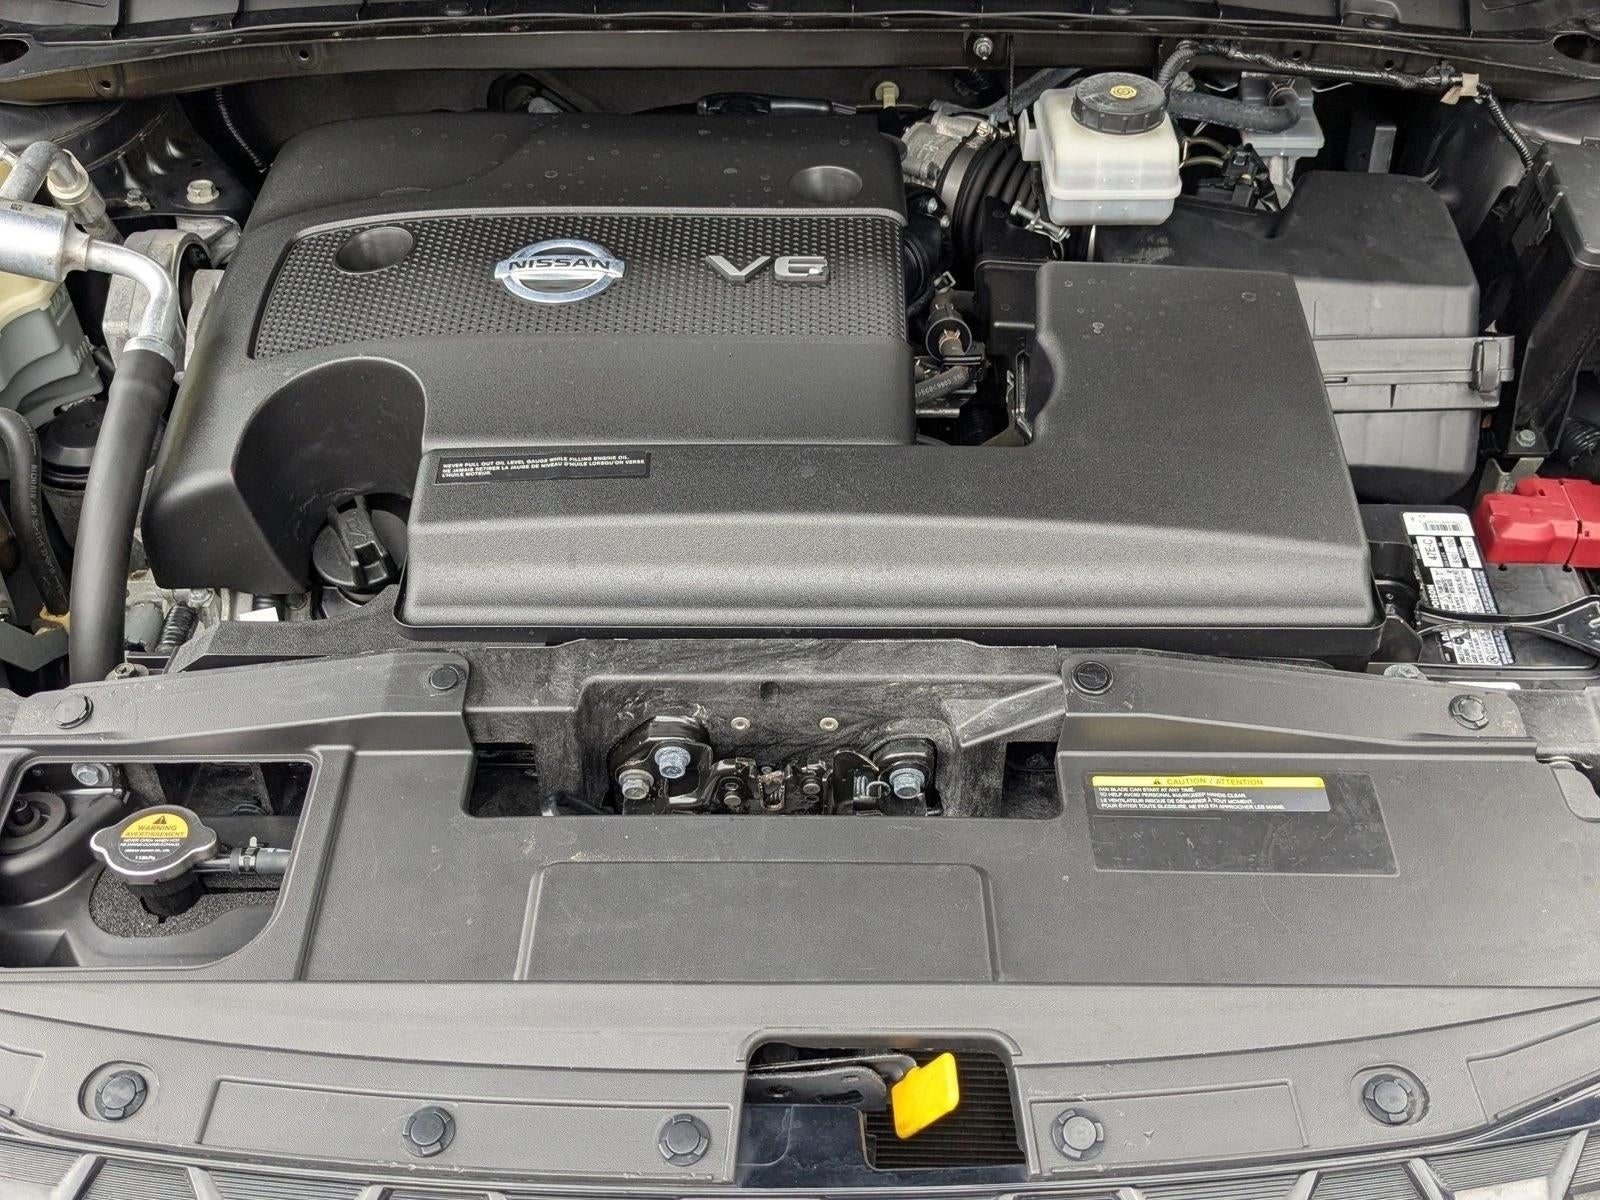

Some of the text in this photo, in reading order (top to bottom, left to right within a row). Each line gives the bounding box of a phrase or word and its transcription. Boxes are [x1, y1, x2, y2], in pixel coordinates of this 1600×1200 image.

[508, 257, 611, 271] NISSAN
[705, 255, 831, 285] V6
[1422, 538, 1438, 561] 47E-C
